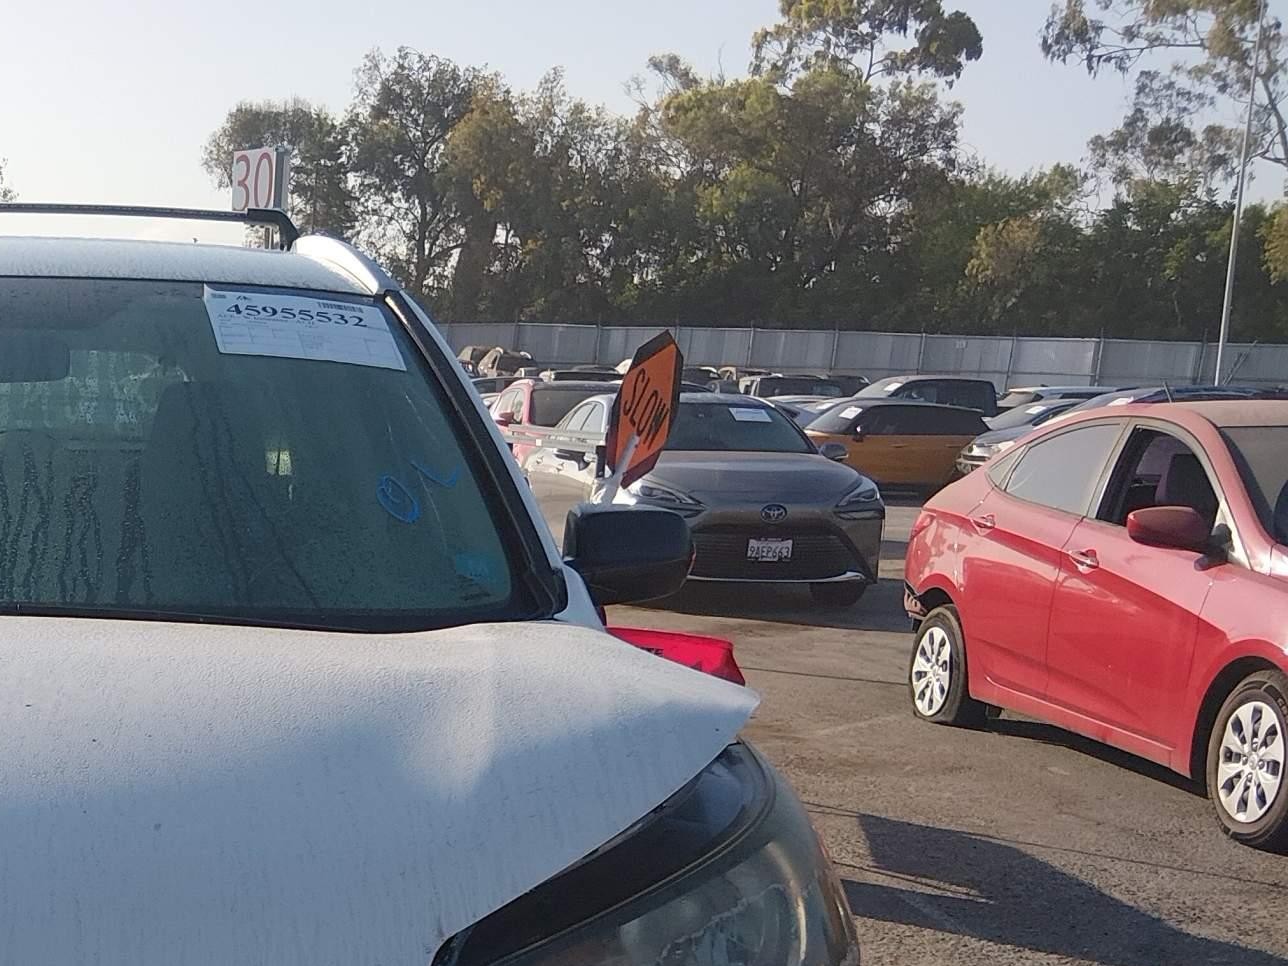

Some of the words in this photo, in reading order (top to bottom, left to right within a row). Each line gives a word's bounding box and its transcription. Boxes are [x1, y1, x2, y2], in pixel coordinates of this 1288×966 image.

[233, 152, 274, 211] 30
[226, 303, 368, 328] 45955532
[623, 367, 670, 450] SLOW
